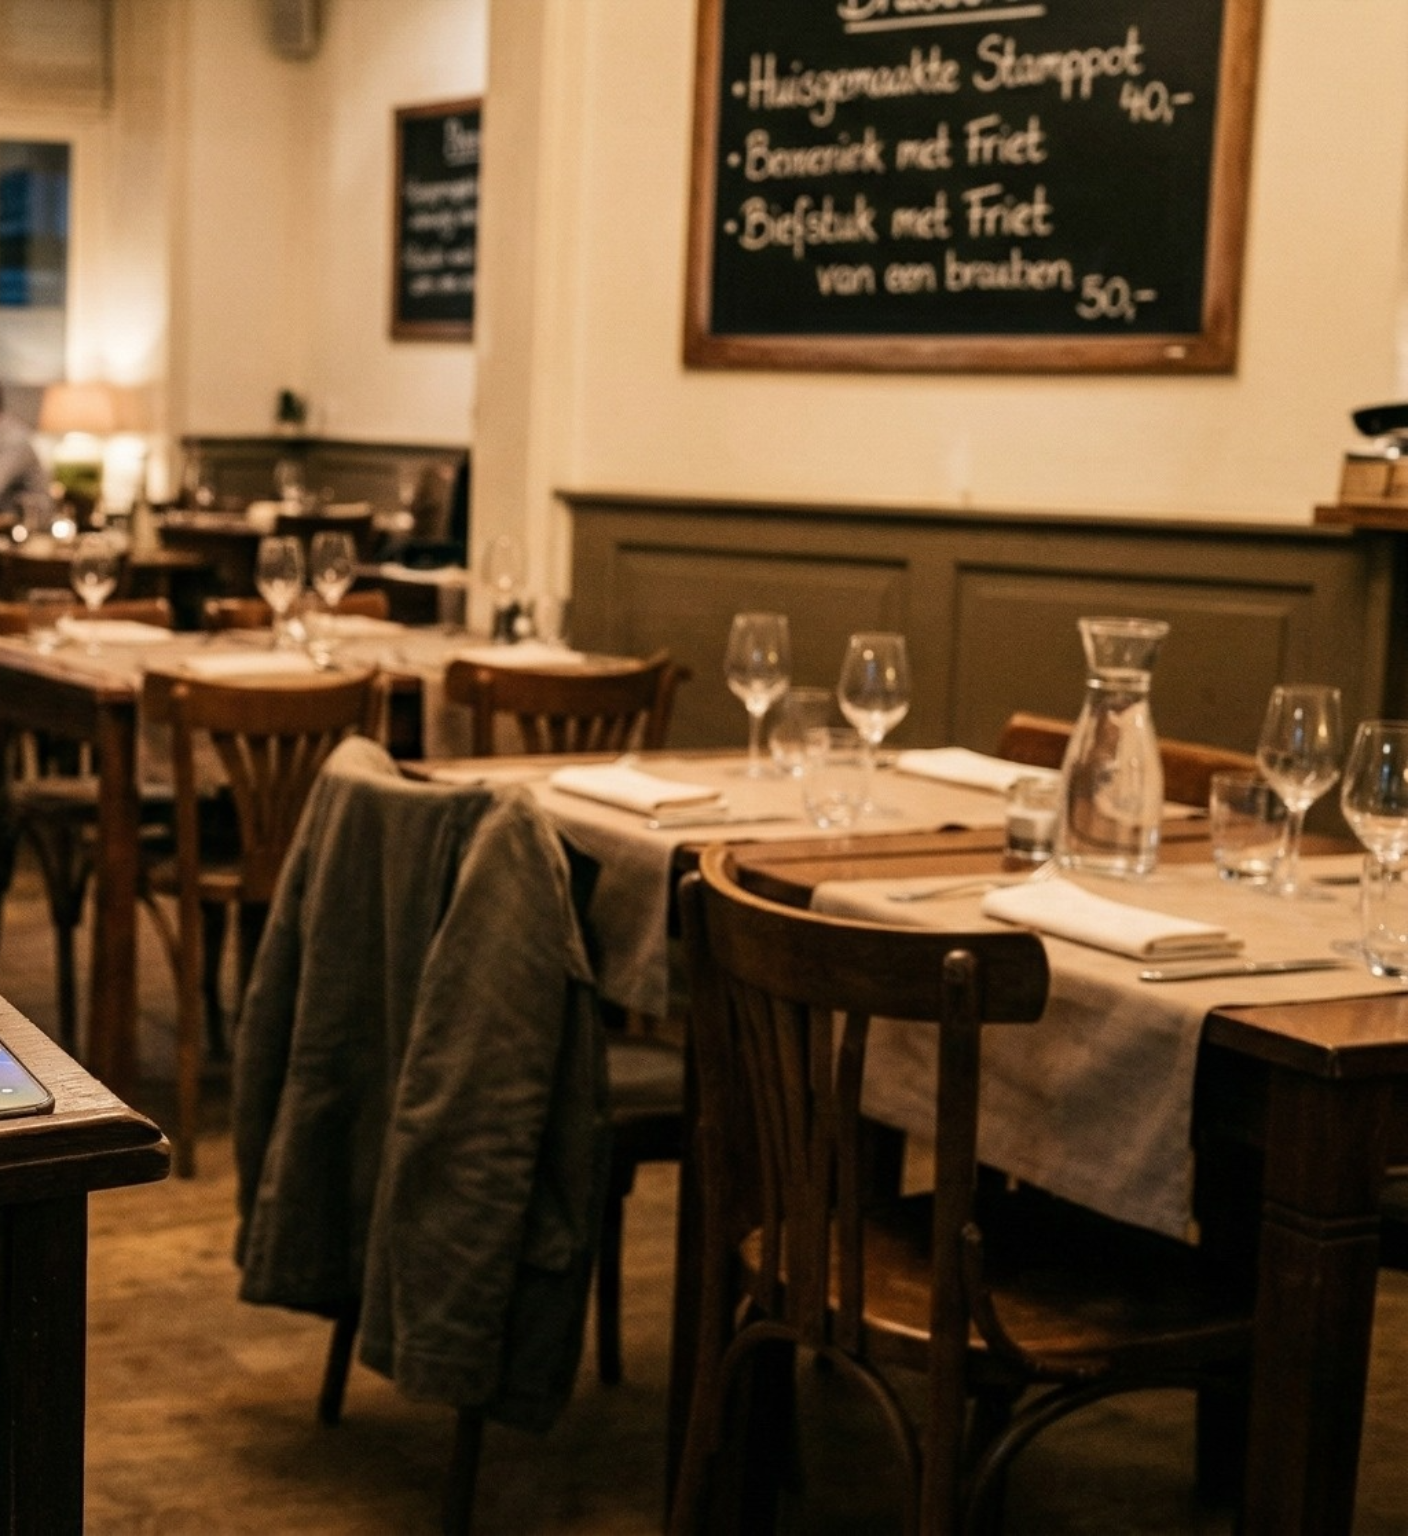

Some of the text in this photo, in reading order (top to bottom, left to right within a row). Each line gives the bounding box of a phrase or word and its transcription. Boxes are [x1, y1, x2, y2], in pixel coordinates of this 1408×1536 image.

[747, 25, 1145, 128] Huisgemaakte Stamppot
[895, 121, 953, 172] met
[963, 113, 1048, 167] Friet
[738, 182, 1055, 261] Biefstuk met Friet
[815, 263, 877, 297] van
[884, 262, 938, 295] een
